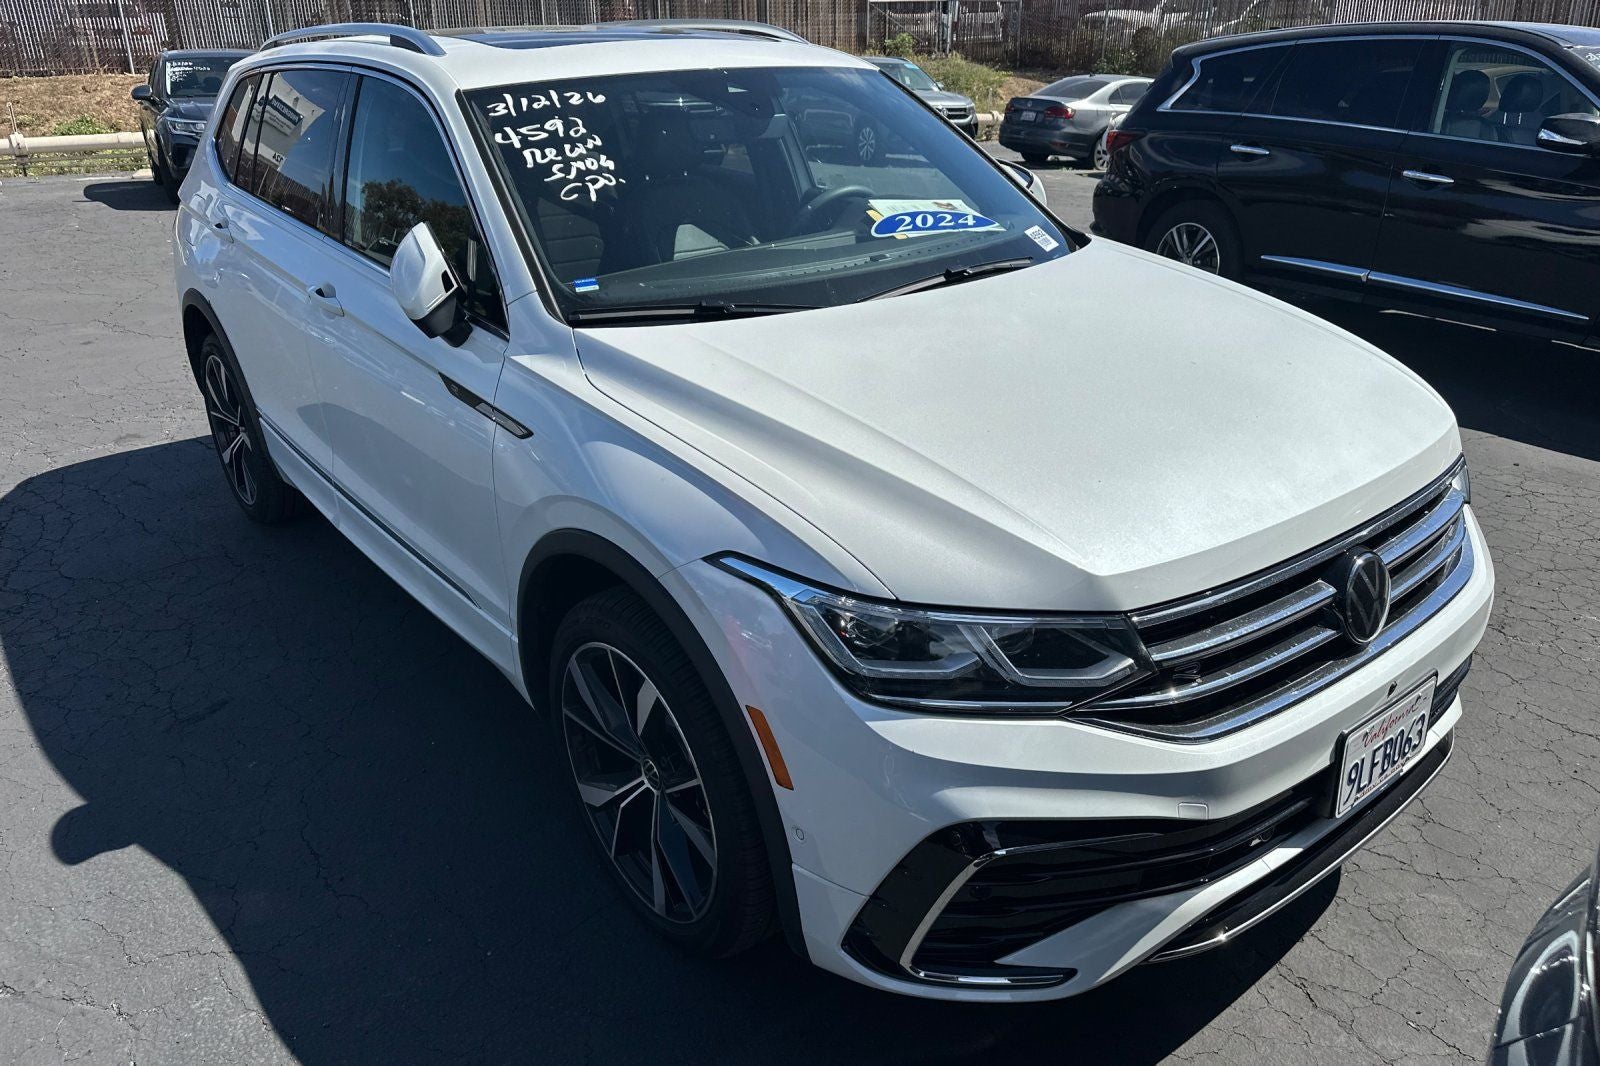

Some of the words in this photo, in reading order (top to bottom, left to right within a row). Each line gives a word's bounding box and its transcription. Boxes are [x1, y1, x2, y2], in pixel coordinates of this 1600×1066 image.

[487, 90, 606, 116] 3/12/26
[495, 116, 587, 148] 4592
[895, 213, 976, 232] 2024
[1343, 713, 1426, 805] 9LFB063
